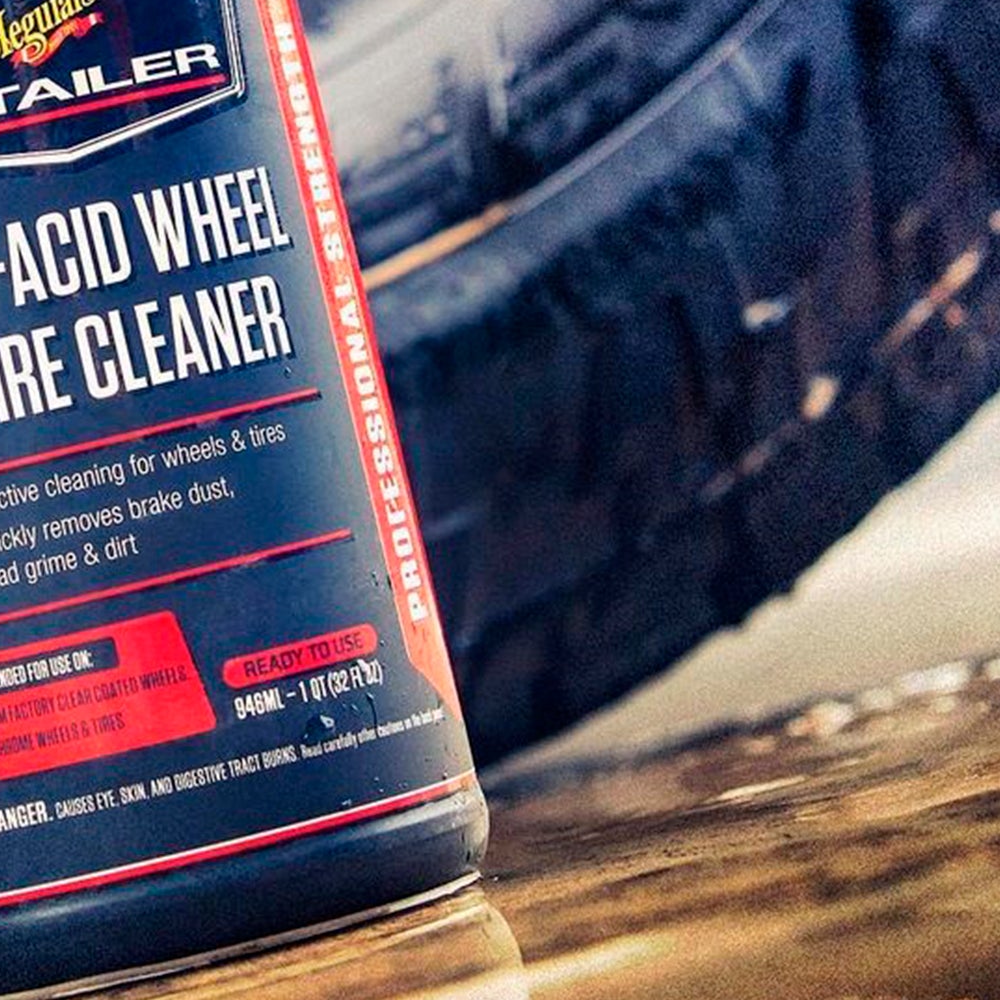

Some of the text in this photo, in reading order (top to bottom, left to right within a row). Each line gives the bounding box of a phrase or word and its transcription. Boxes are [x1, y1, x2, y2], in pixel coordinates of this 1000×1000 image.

[274, 22, 345, 262] STRENGTH
[133, 166, 290, 274] WHEEL
[74, 274, 293, 400] CLEANER
[44, 462, 126, 498] cleaning
[129, 454, 156, 476] for
[161, 435, 227, 468] wheels
[231, 429, 247, 452] &
[249, 423, 287, 448] tires
[333, 275, 429, 622] PROFESSIONAL
[42, 505, 124, 540] removes
[127, 490, 183, 520] brake
[188, 476, 235, 505] dust,
[24, 551, 78, 584] grime
[83, 543, 100, 566] &
[104, 534, 139, 560] dirt
[26, 659, 50, 683] FOR
[49, 654, 73, 677] USE
[243, 632, 364, 677] READY TO USE
[7, 696, 55, 724] FACTORY
[57, 688, 94, 712] CLEAR
[95, 677, 139, 702] COATED
[36, 724, 80, 751] WHEELS
[93, 712, 126, 735] TIRES
[234, 687, 285, 720] 946ML
[299, 681, 308, 703] 1
[55, 793, 96, 820] CAUSES
[150, 776, 173, 799] AND
[174, 762, 229, 792] DIGESTIVE
[228, 753, 262, 778] TRACT
[301, 741, 323, 760] Read
[323, 731, 357, 754] carefully
